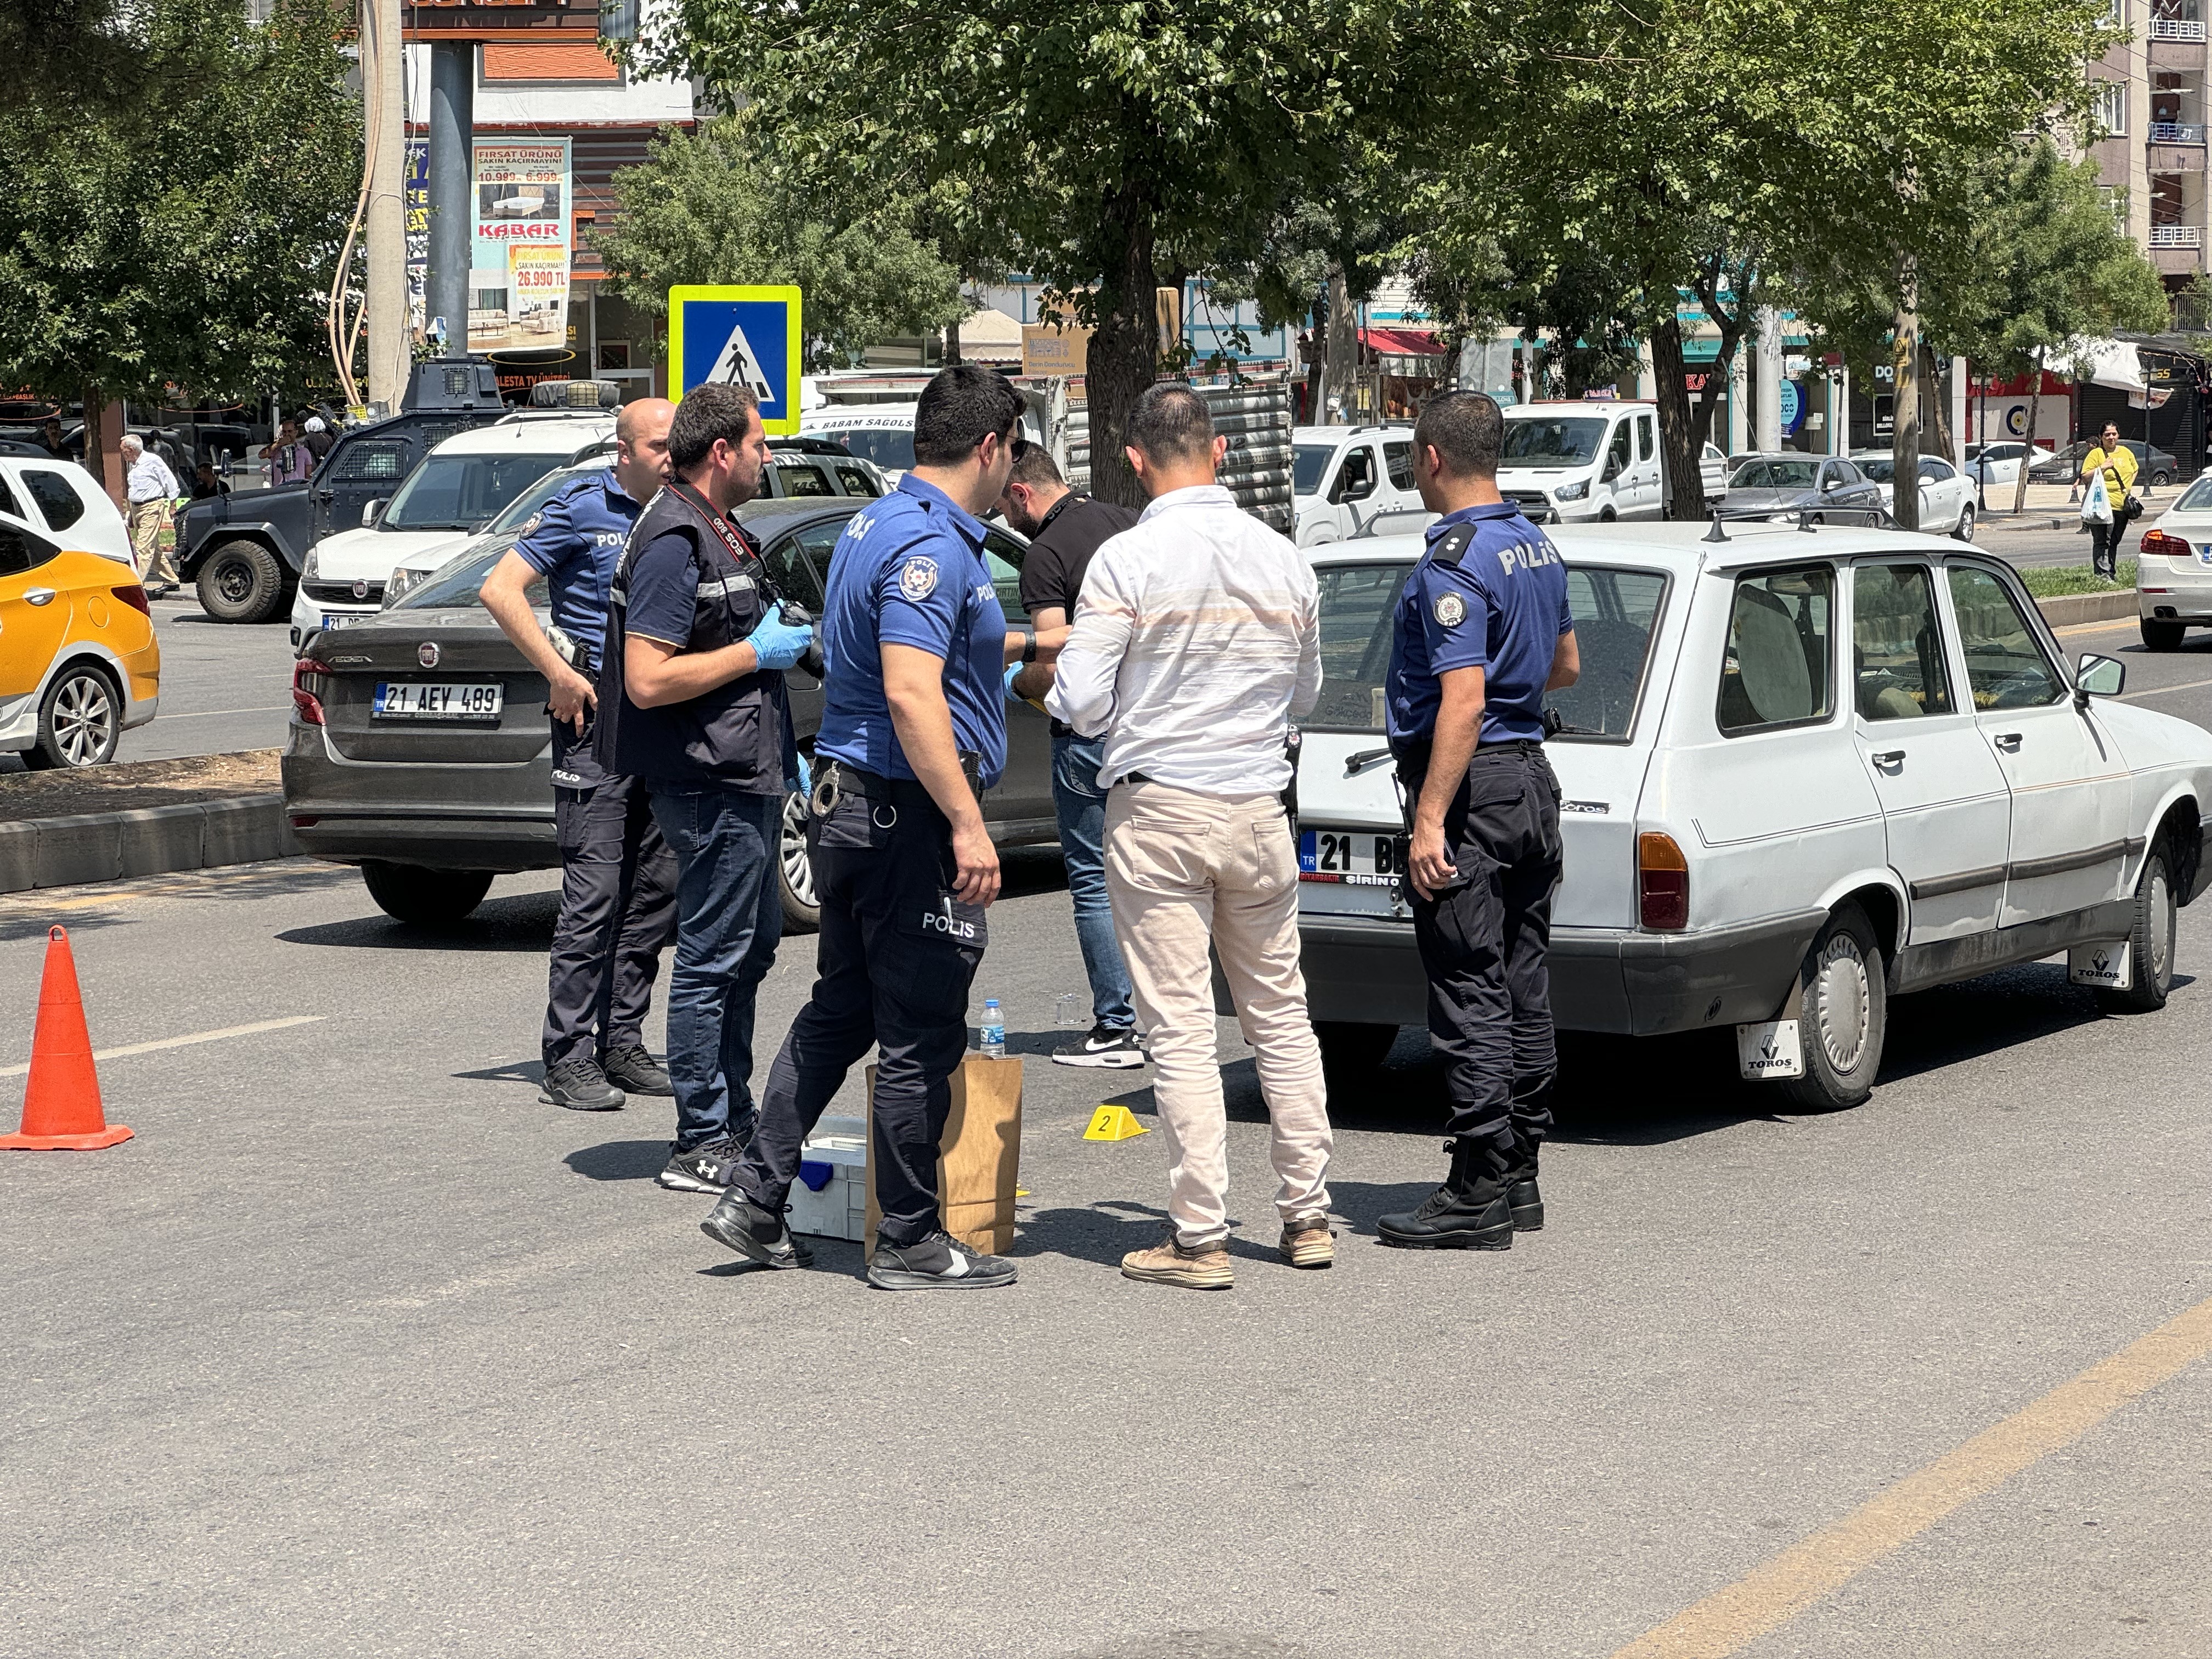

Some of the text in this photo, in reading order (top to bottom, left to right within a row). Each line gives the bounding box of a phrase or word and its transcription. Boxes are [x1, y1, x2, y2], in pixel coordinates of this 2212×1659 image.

[478, 172, 516, 182] 10.999
[526, 172, 557, 182] 6.999
[478, 224, 560, 237] KABAR
[517, 271, 565, 286] 26.990 TL
[526, 375, 537, 386] TV
[821, 417, 914, 430] BABAM SAĞOLS
[713, 517, 728, 534] 80D
[596, 532, 628, 547] POL
[330, 617, 340, 630] 21
[386, 687, 408, 710] 21
[461, 687, 496, 712] 489
[1321, 834, 1351, 871] 21
[1302, 855, 1315, 866] TR
[2078, 969, 2120, 979] TOROS
[1748, 1059, 1792, 1069] TOROS
[1098, 1115, 1111, 1132] 2
